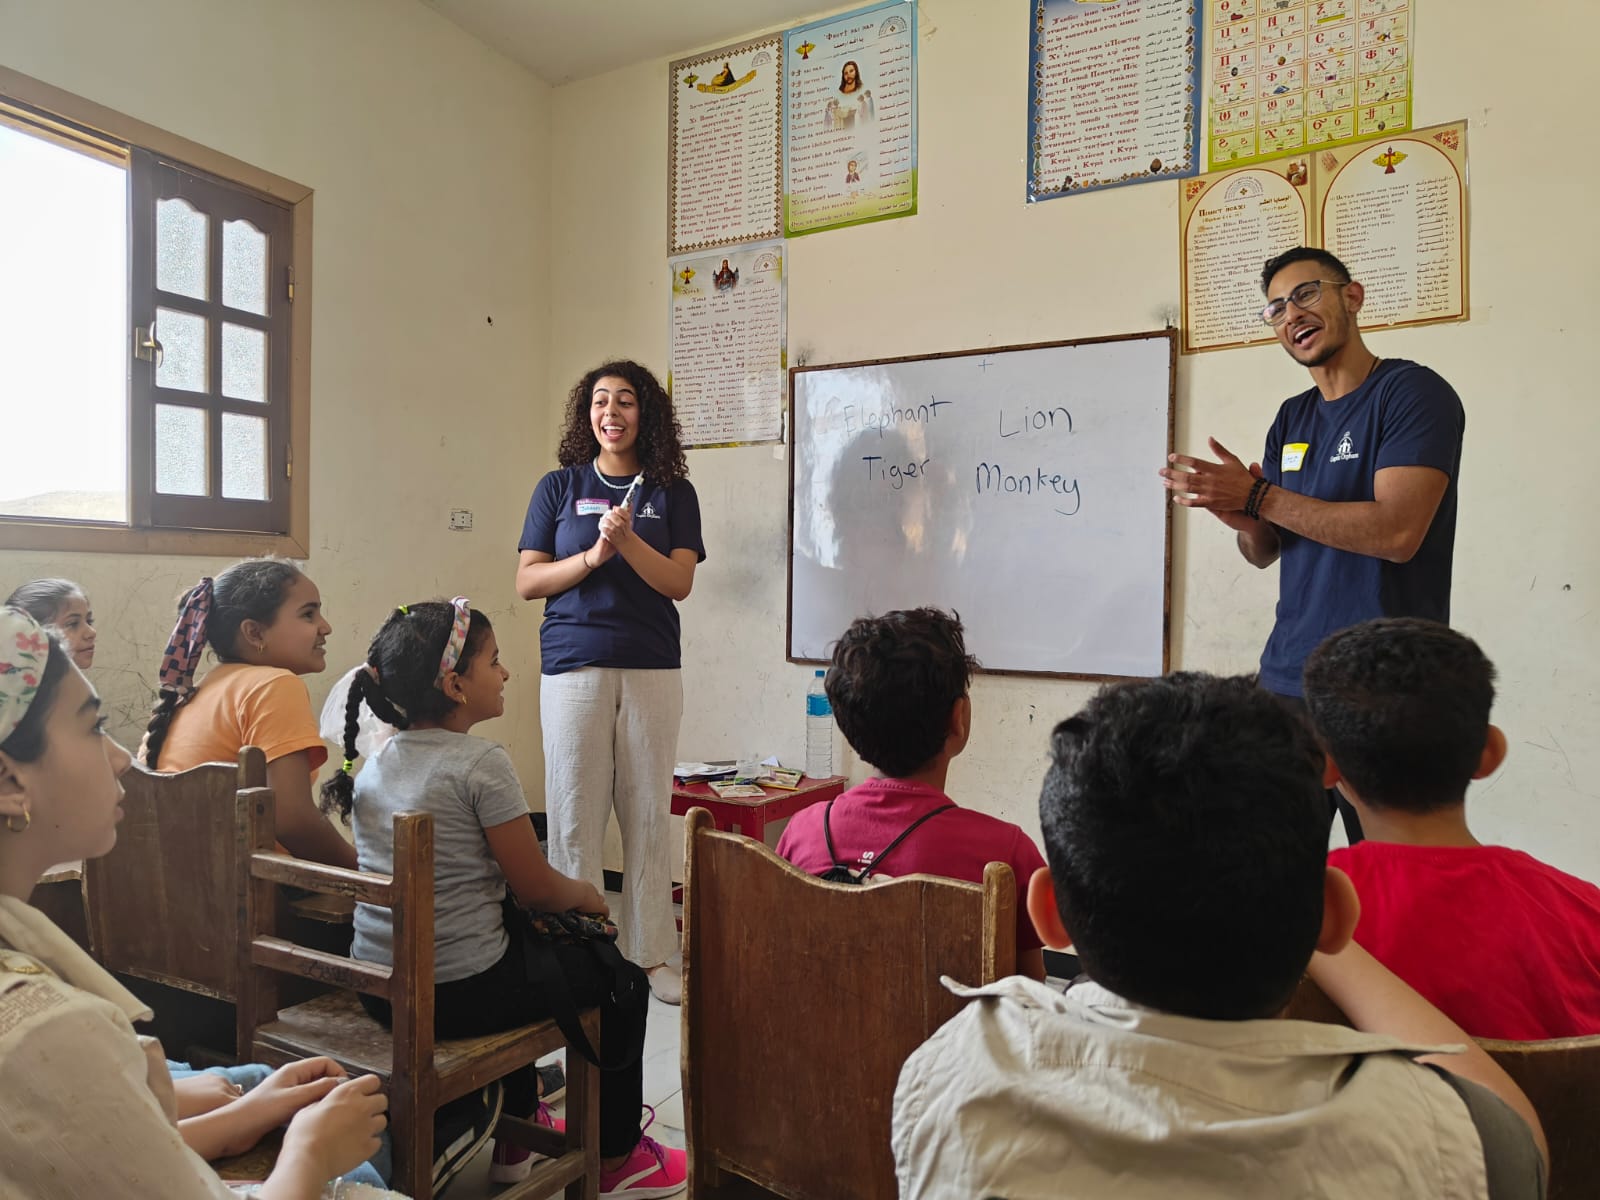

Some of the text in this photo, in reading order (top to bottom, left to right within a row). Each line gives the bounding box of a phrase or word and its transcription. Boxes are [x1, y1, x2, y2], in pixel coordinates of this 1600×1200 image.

[843, 394, 1073, 438] Elephant Lion
[862, 456, 1081, 516] Tiger Monkey
